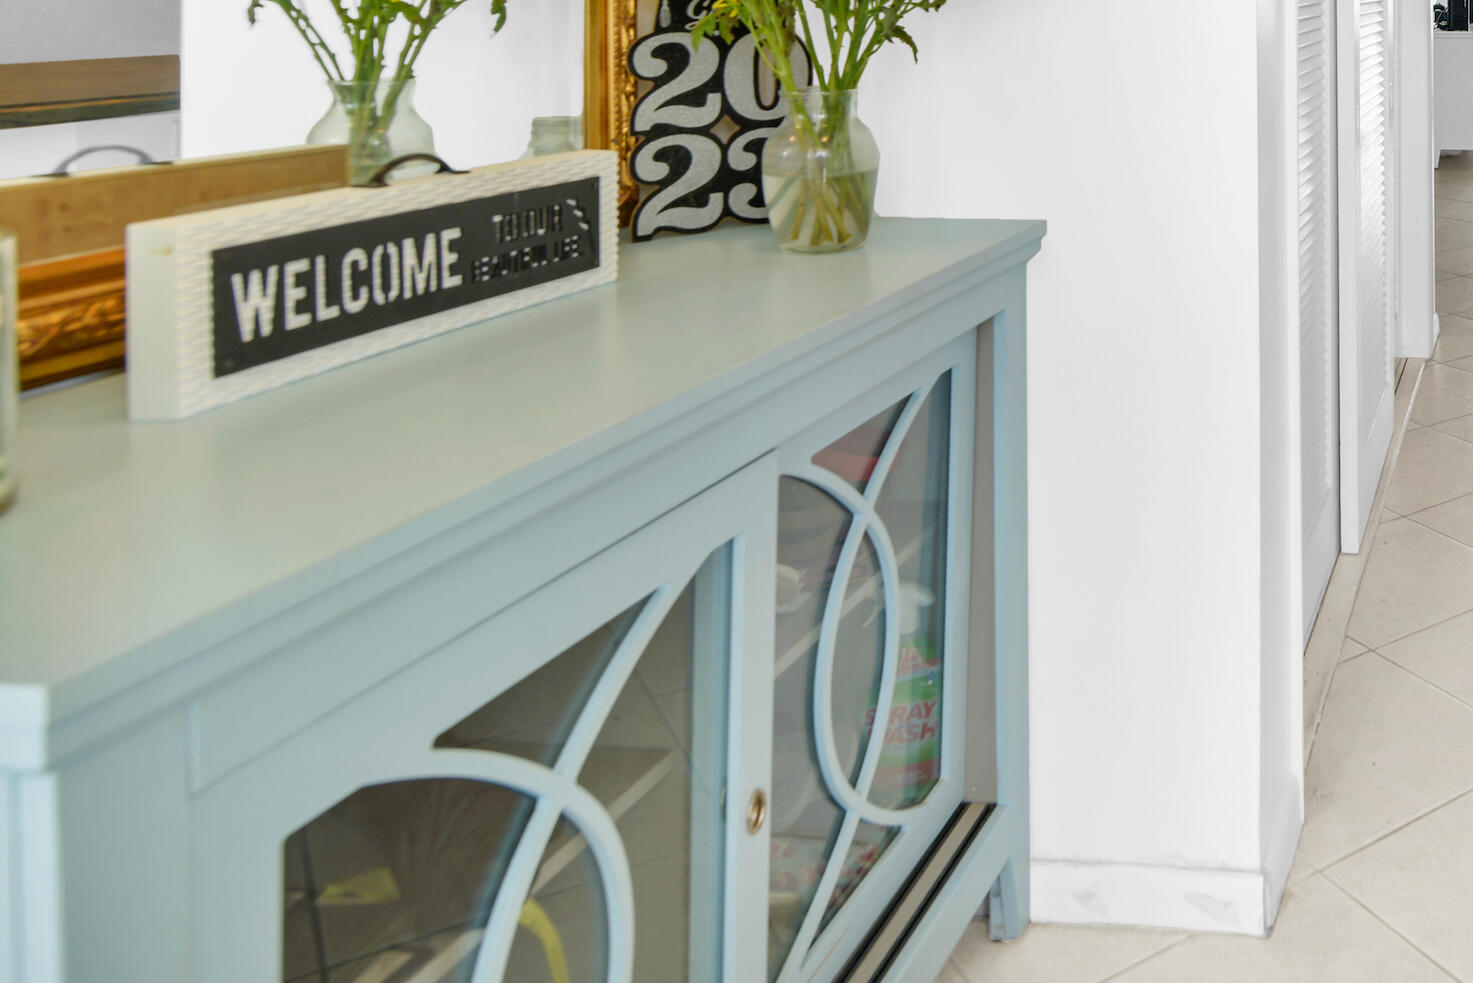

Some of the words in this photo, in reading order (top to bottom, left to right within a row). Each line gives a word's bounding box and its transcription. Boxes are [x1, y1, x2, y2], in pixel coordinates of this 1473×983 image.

[632, 31, 811, 133] 20
[230, 226, 464, 343] WELCOME
[864, 699, 939, 727] SRAY
